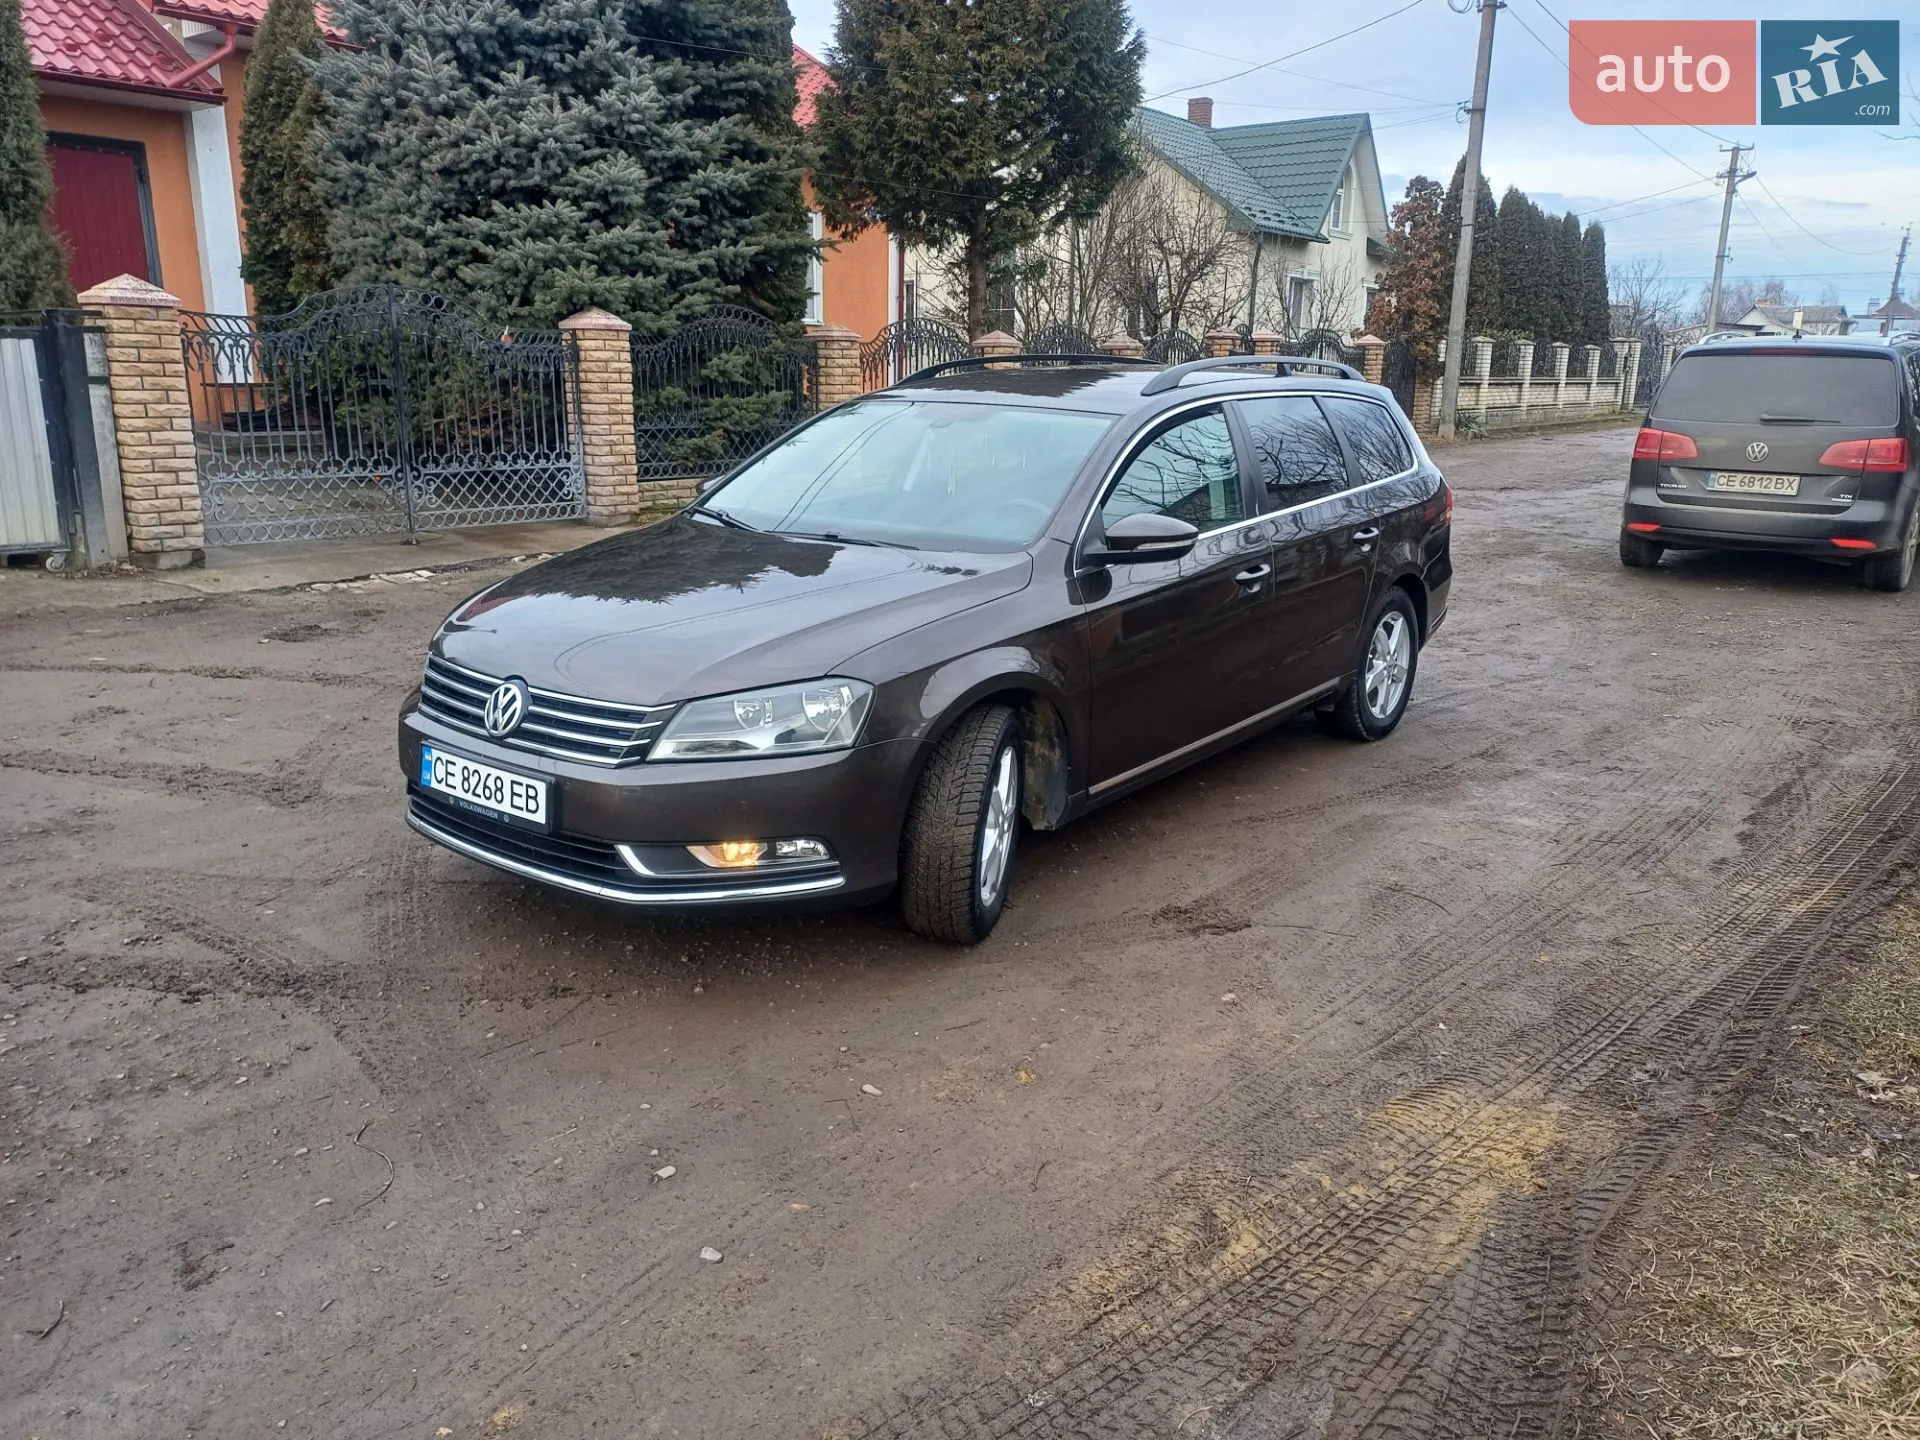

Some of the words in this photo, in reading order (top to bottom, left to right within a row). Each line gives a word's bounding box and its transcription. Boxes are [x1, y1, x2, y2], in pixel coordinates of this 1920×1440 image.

[1716, 474, 1738, 487] CE
[1739, 475, 1773, 490] 6812
[1774, 477, 1797, 491] BX
[433, 756, 457, 790] CE
[461, 765, 505, 805] 8268
[510, 779, 540, 815] EB
